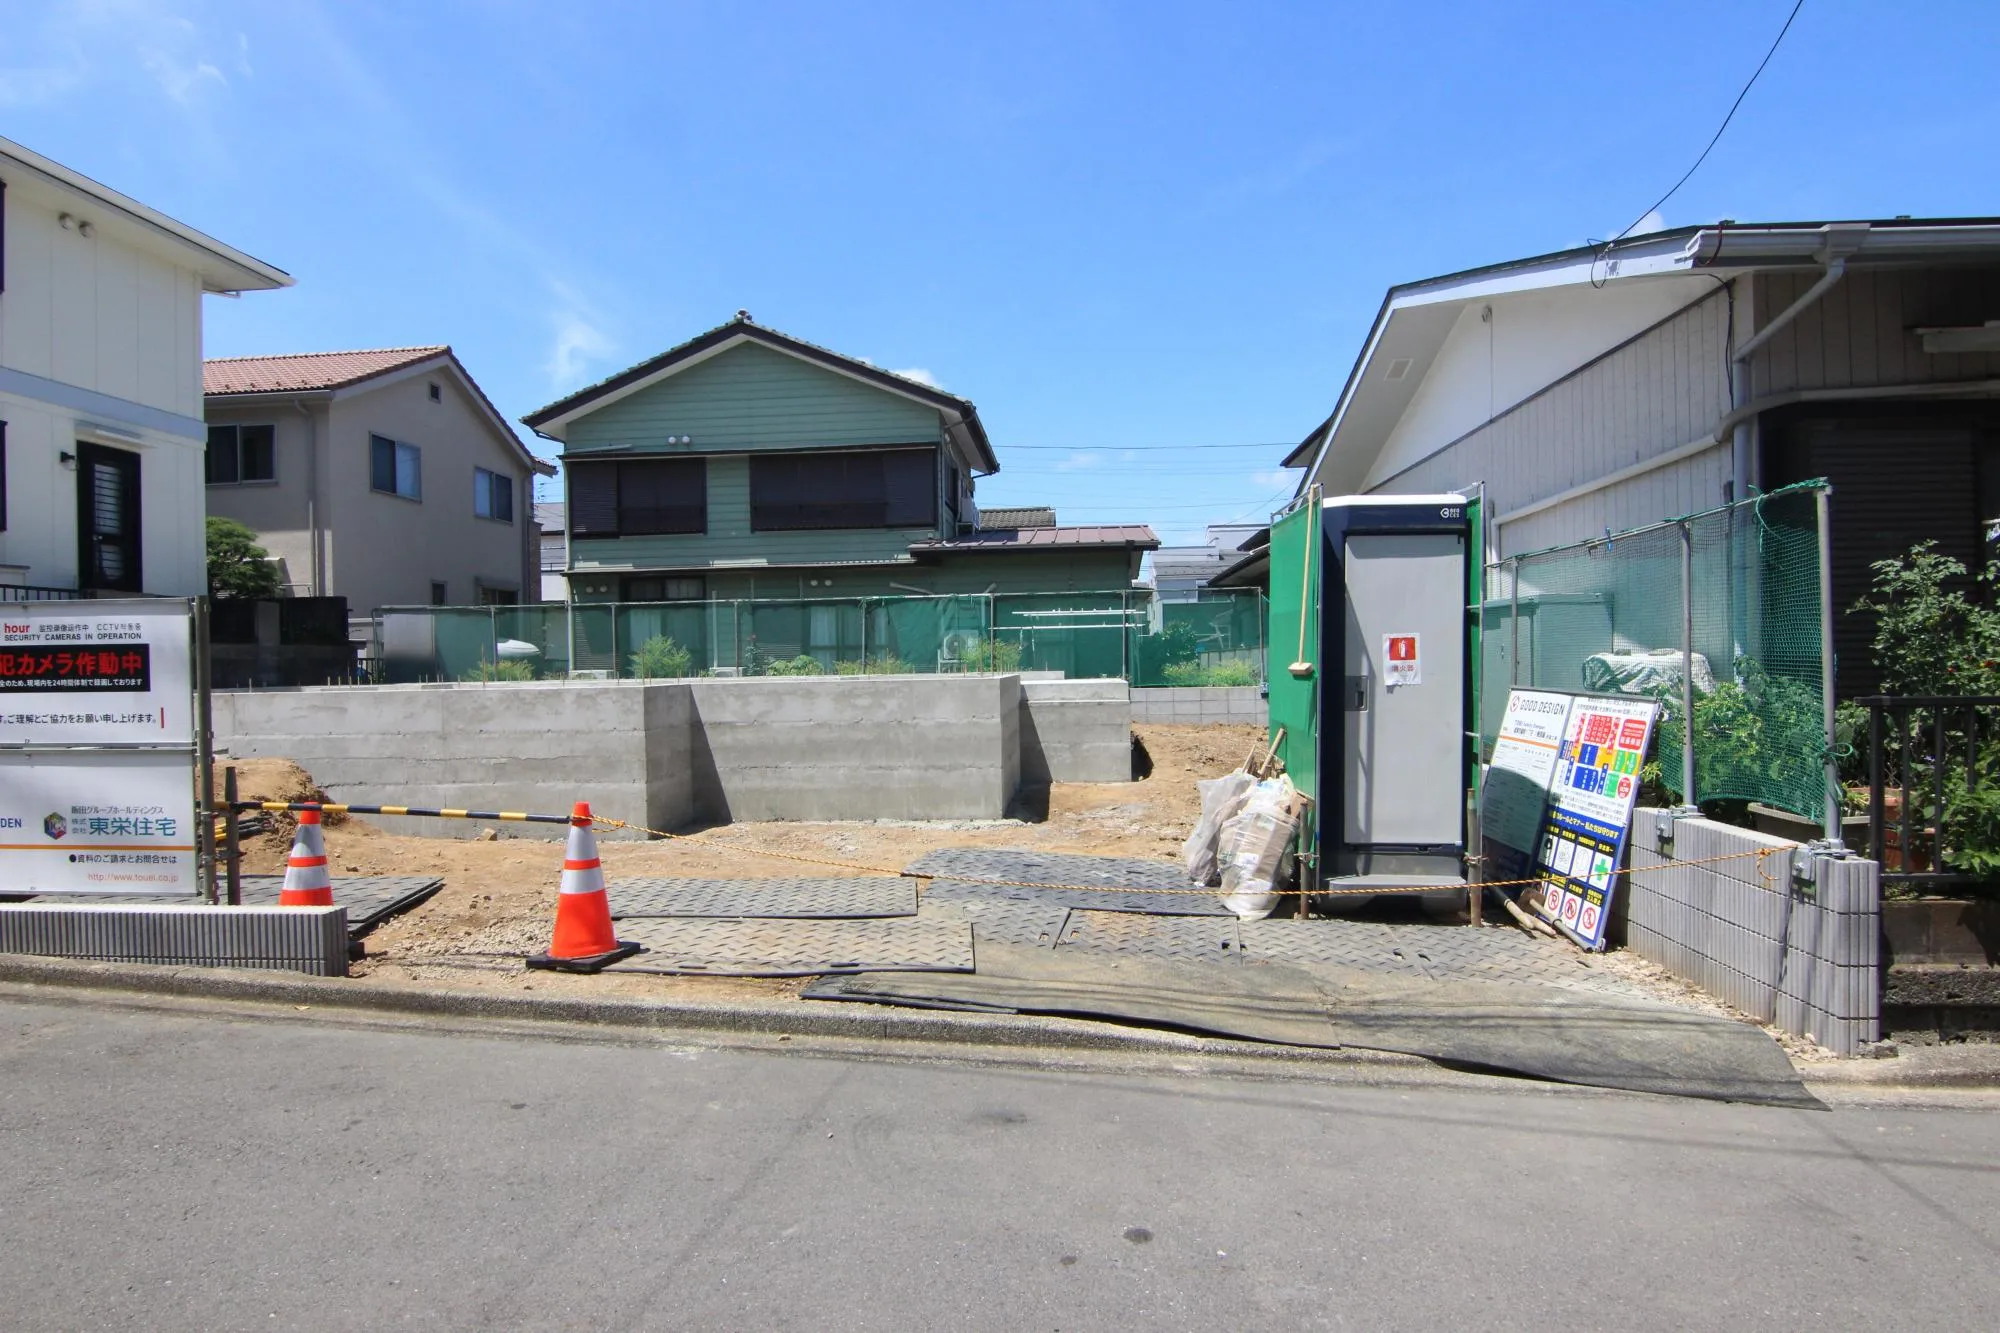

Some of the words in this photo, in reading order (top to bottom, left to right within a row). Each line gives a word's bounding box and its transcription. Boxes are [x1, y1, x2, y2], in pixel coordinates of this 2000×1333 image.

[4, 623, 31, 633] hour
[45, 633, 81, 641] CAMERAS
[97, 632, 142, 640] OPERATION
[1520, 699, 1538, 712] GOOD
[1538, 702, 1565, 715] DESIGN
[1, 818, 22, 828] DEN
[88, 817, 177, 836] 東栄住宅
